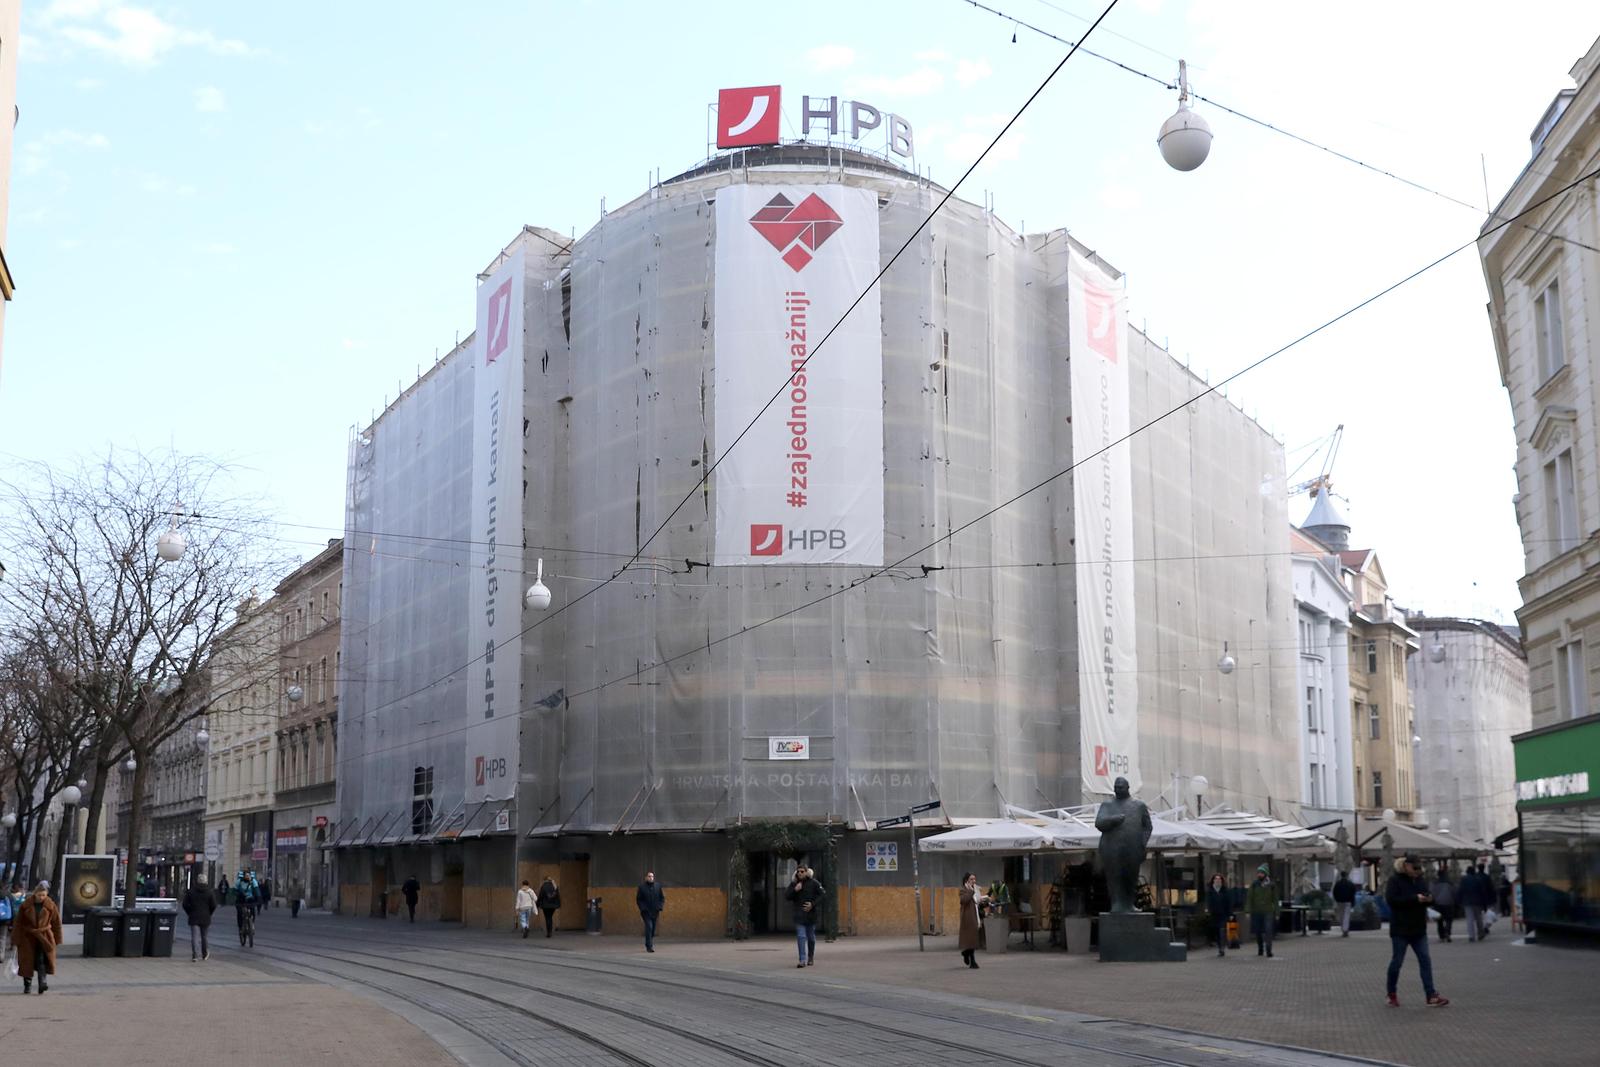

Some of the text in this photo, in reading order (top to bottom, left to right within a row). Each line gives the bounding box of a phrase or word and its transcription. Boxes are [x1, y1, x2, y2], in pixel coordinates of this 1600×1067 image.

[802, 95, 914, 158] HPB
[785, 290, 812, 508] #zajednosnažniji
[485, 390, 499, 719] HPB digitalni kanali
[788, 529, 846, 550] HPB
[1100, 375, 1114, 714] mHPB mobilno bankarstvo
[486, 757, 506, 779] HPB
[1109, 753, 1129, 775] HPB
